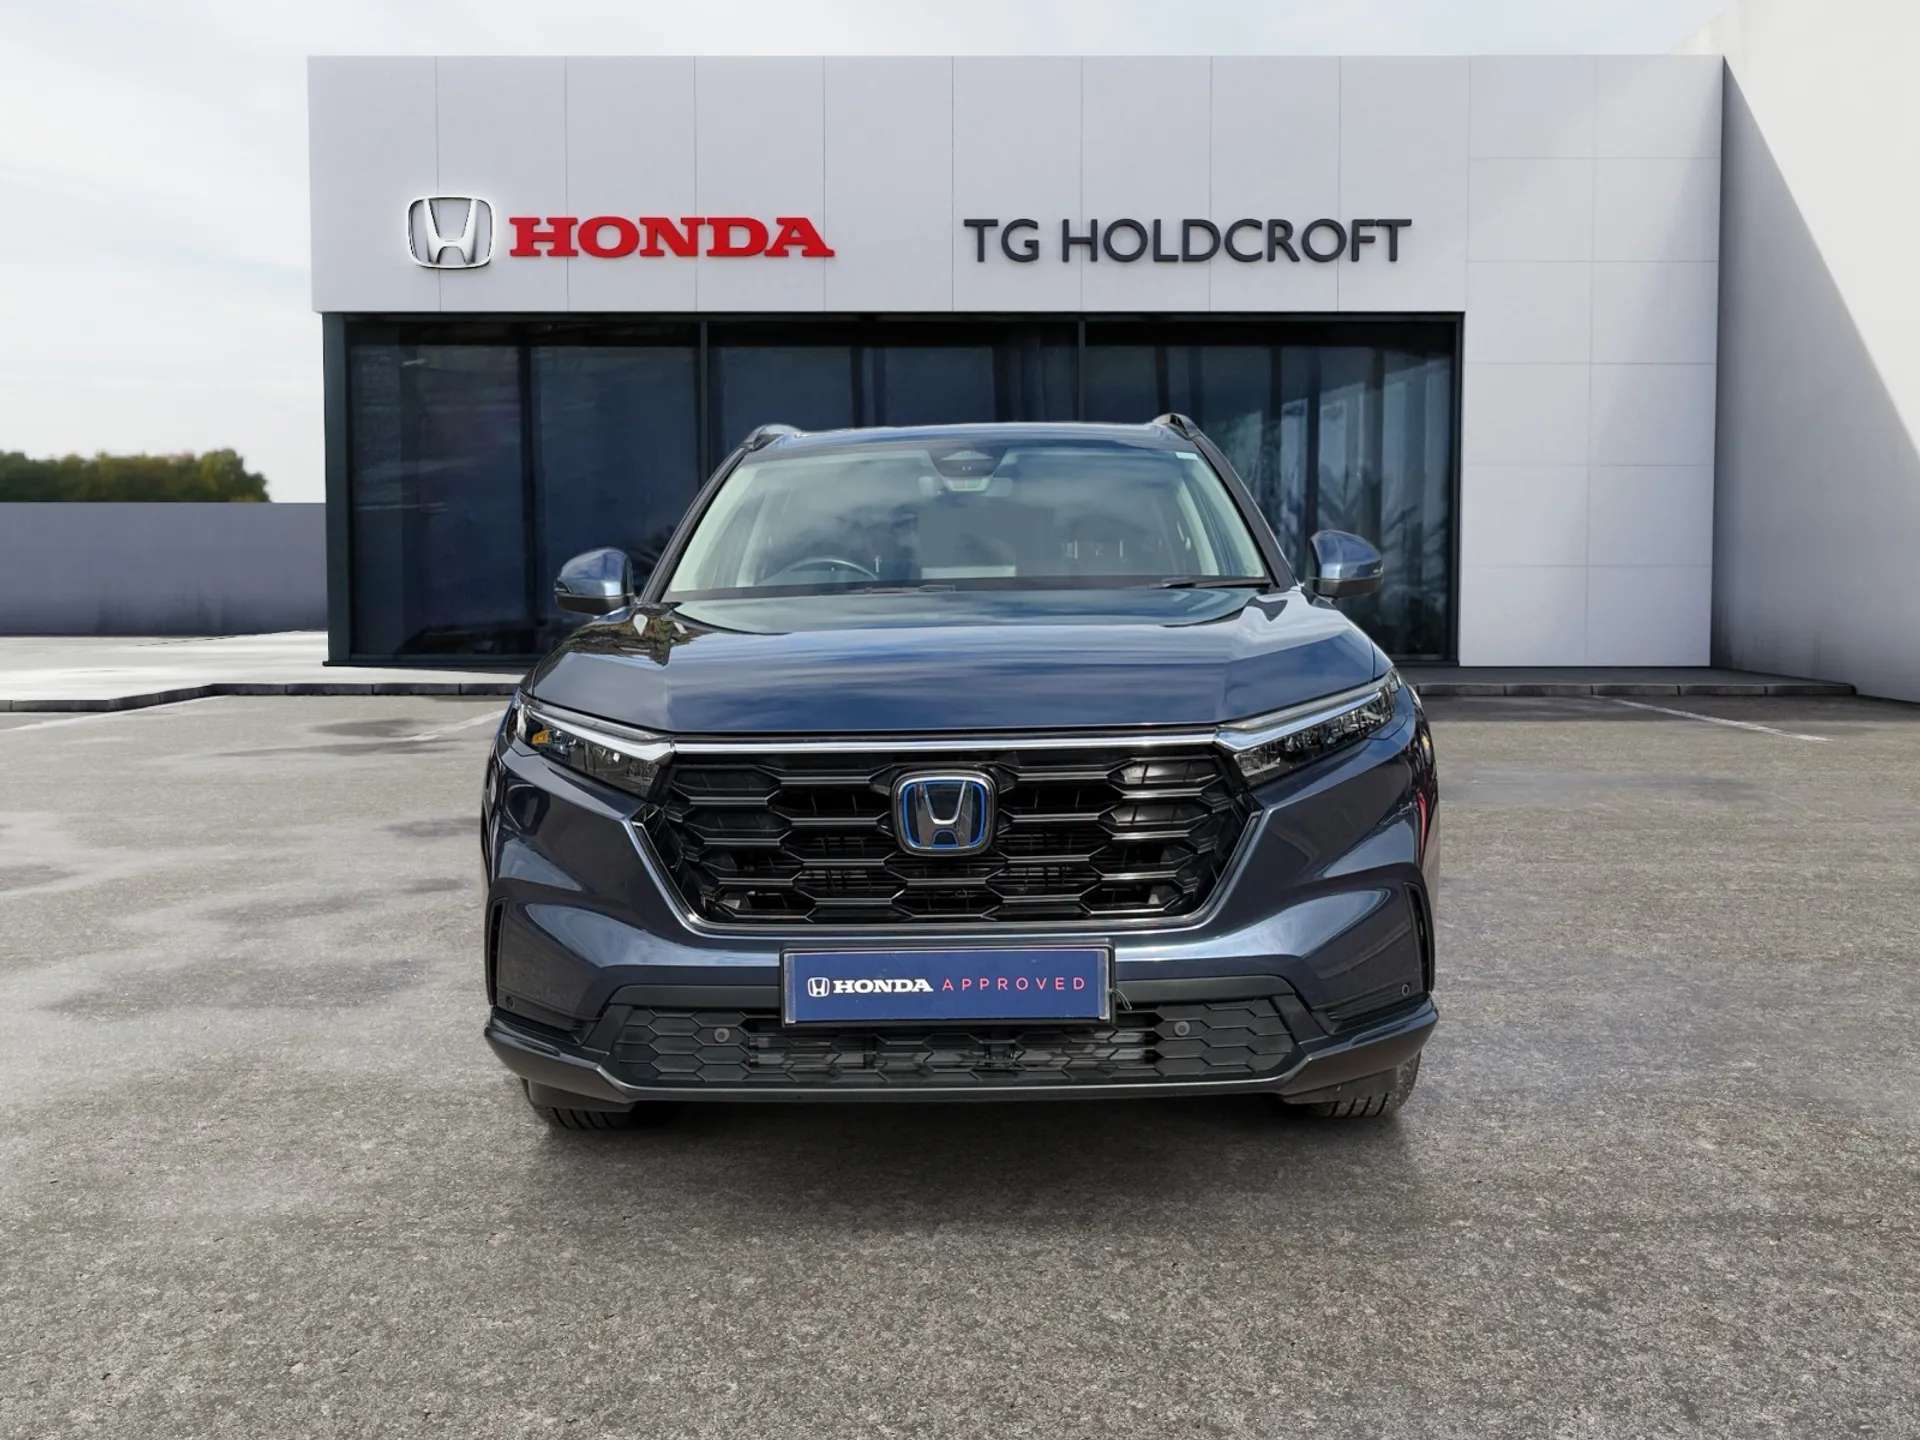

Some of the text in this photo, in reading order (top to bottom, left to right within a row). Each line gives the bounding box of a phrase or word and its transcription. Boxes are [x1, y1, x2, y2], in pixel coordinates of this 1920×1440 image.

[509, 216, 835, 258] HONDA
[963, 218, 1412, 263] TG HOLDCROFT
[833, 979, 934, 994] HONDA
[942, 977, 1086, 991] APPROVED
